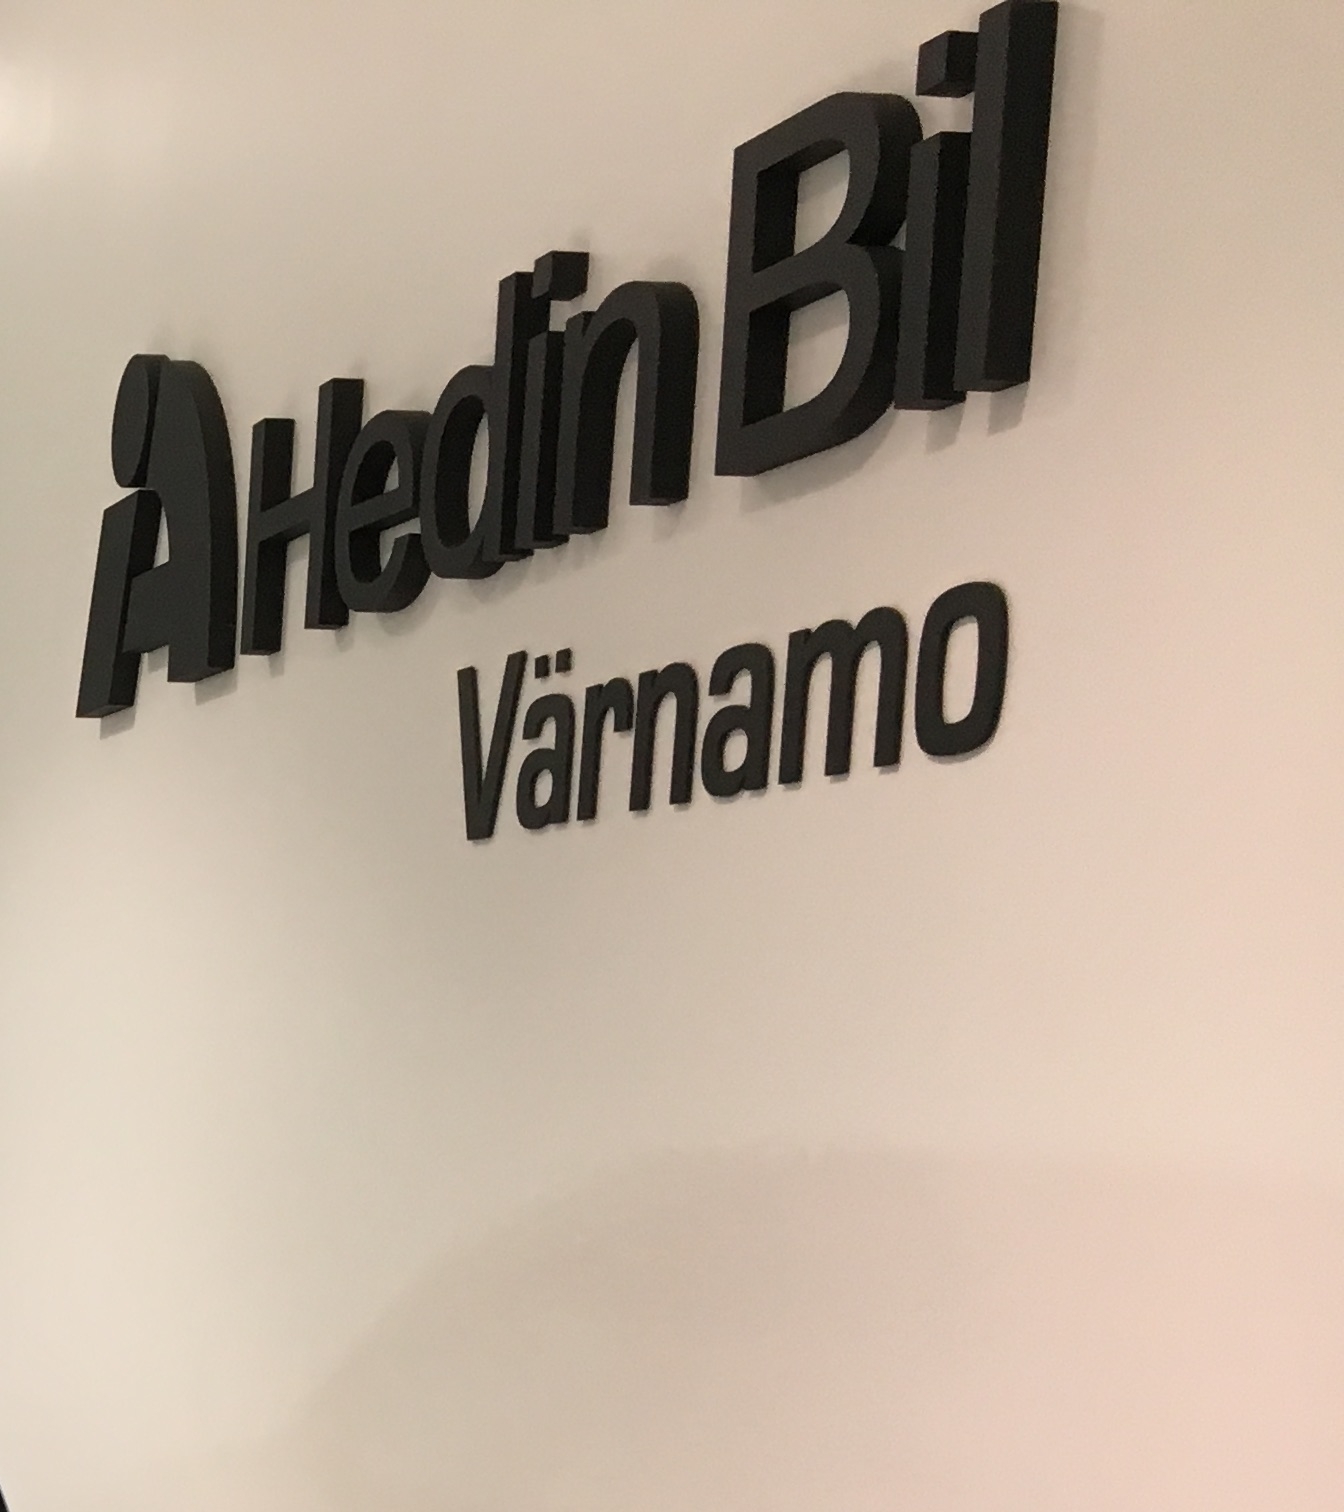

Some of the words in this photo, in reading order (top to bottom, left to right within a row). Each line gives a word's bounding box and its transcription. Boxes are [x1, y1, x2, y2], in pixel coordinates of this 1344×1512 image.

[241, 250, 700, 655] Hedin
[715, 0, 1058, 477] Bil
[456, 580, 1010, 841] Värnamo
